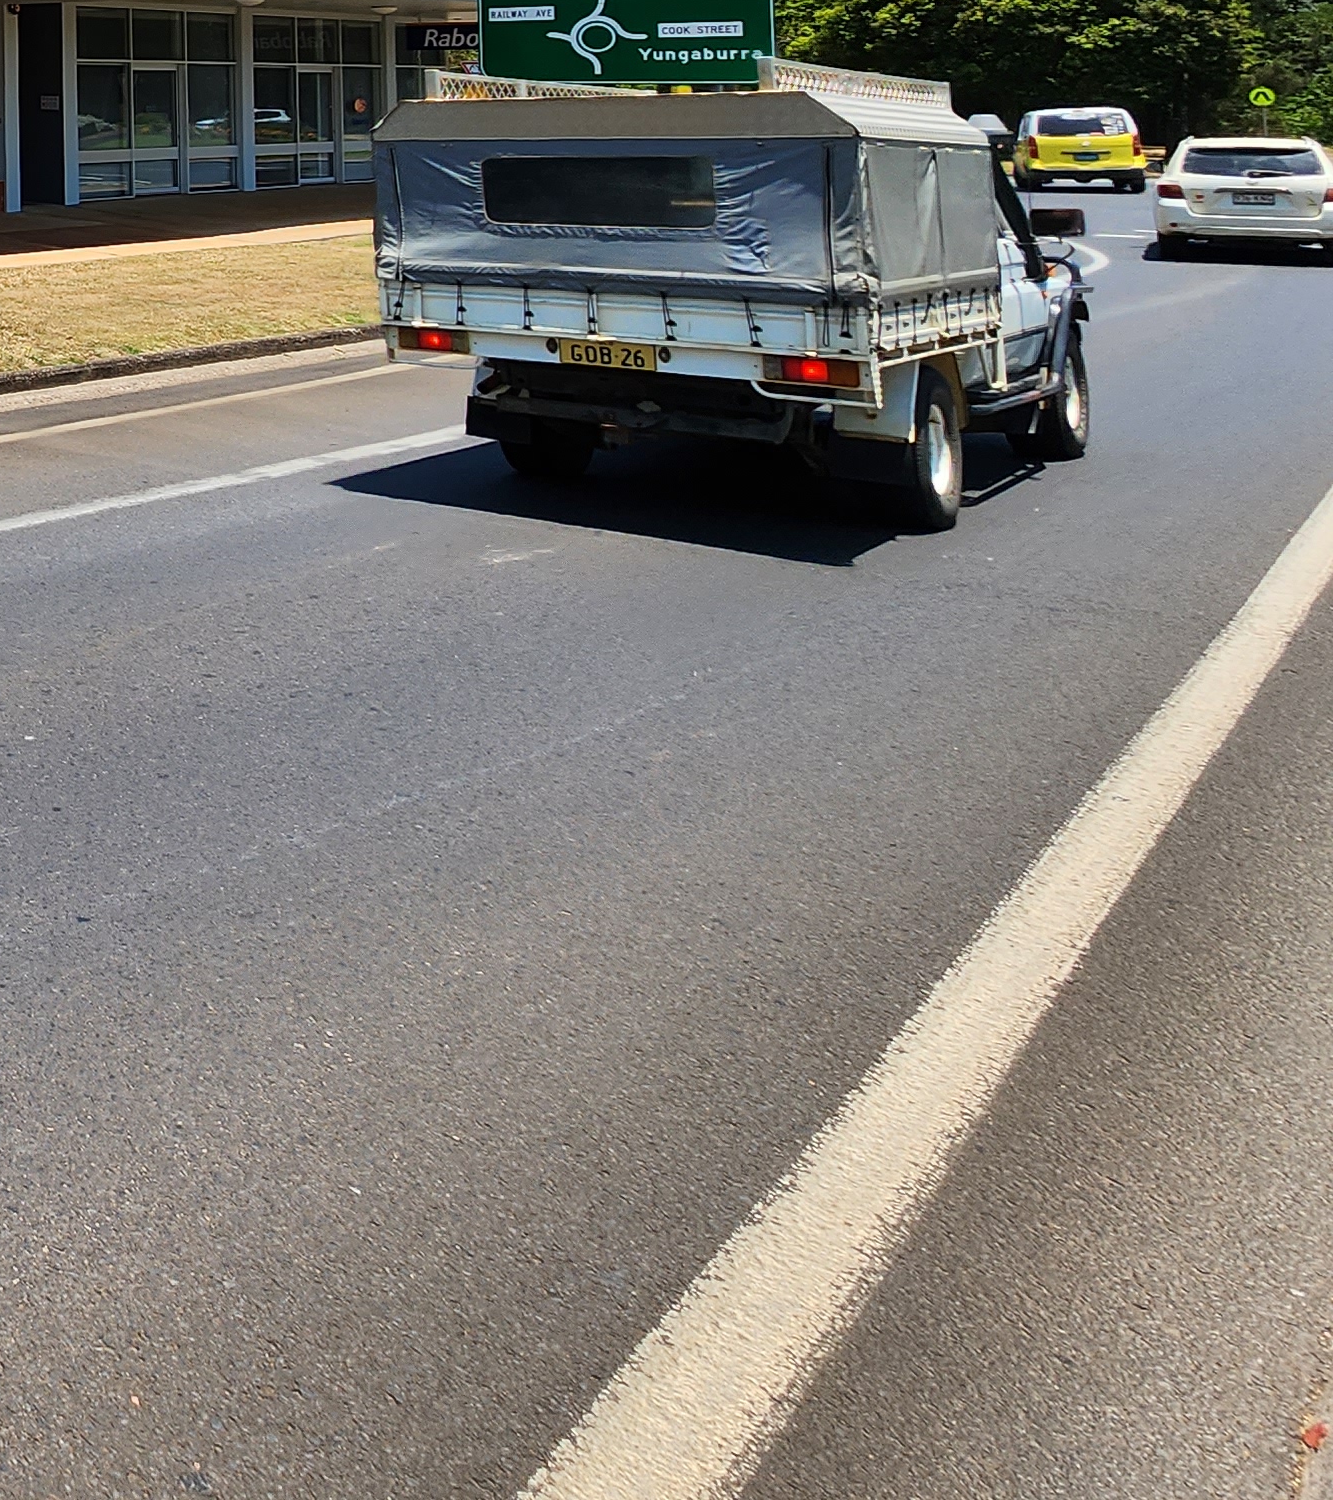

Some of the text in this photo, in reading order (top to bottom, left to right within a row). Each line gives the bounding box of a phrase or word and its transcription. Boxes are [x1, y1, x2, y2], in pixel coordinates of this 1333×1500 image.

[490, 8, 552, 19] RAILWAY AVE
[661, 25, 738, 35] COOK STREET
[638, 47, 763, 64] Yungaburra
